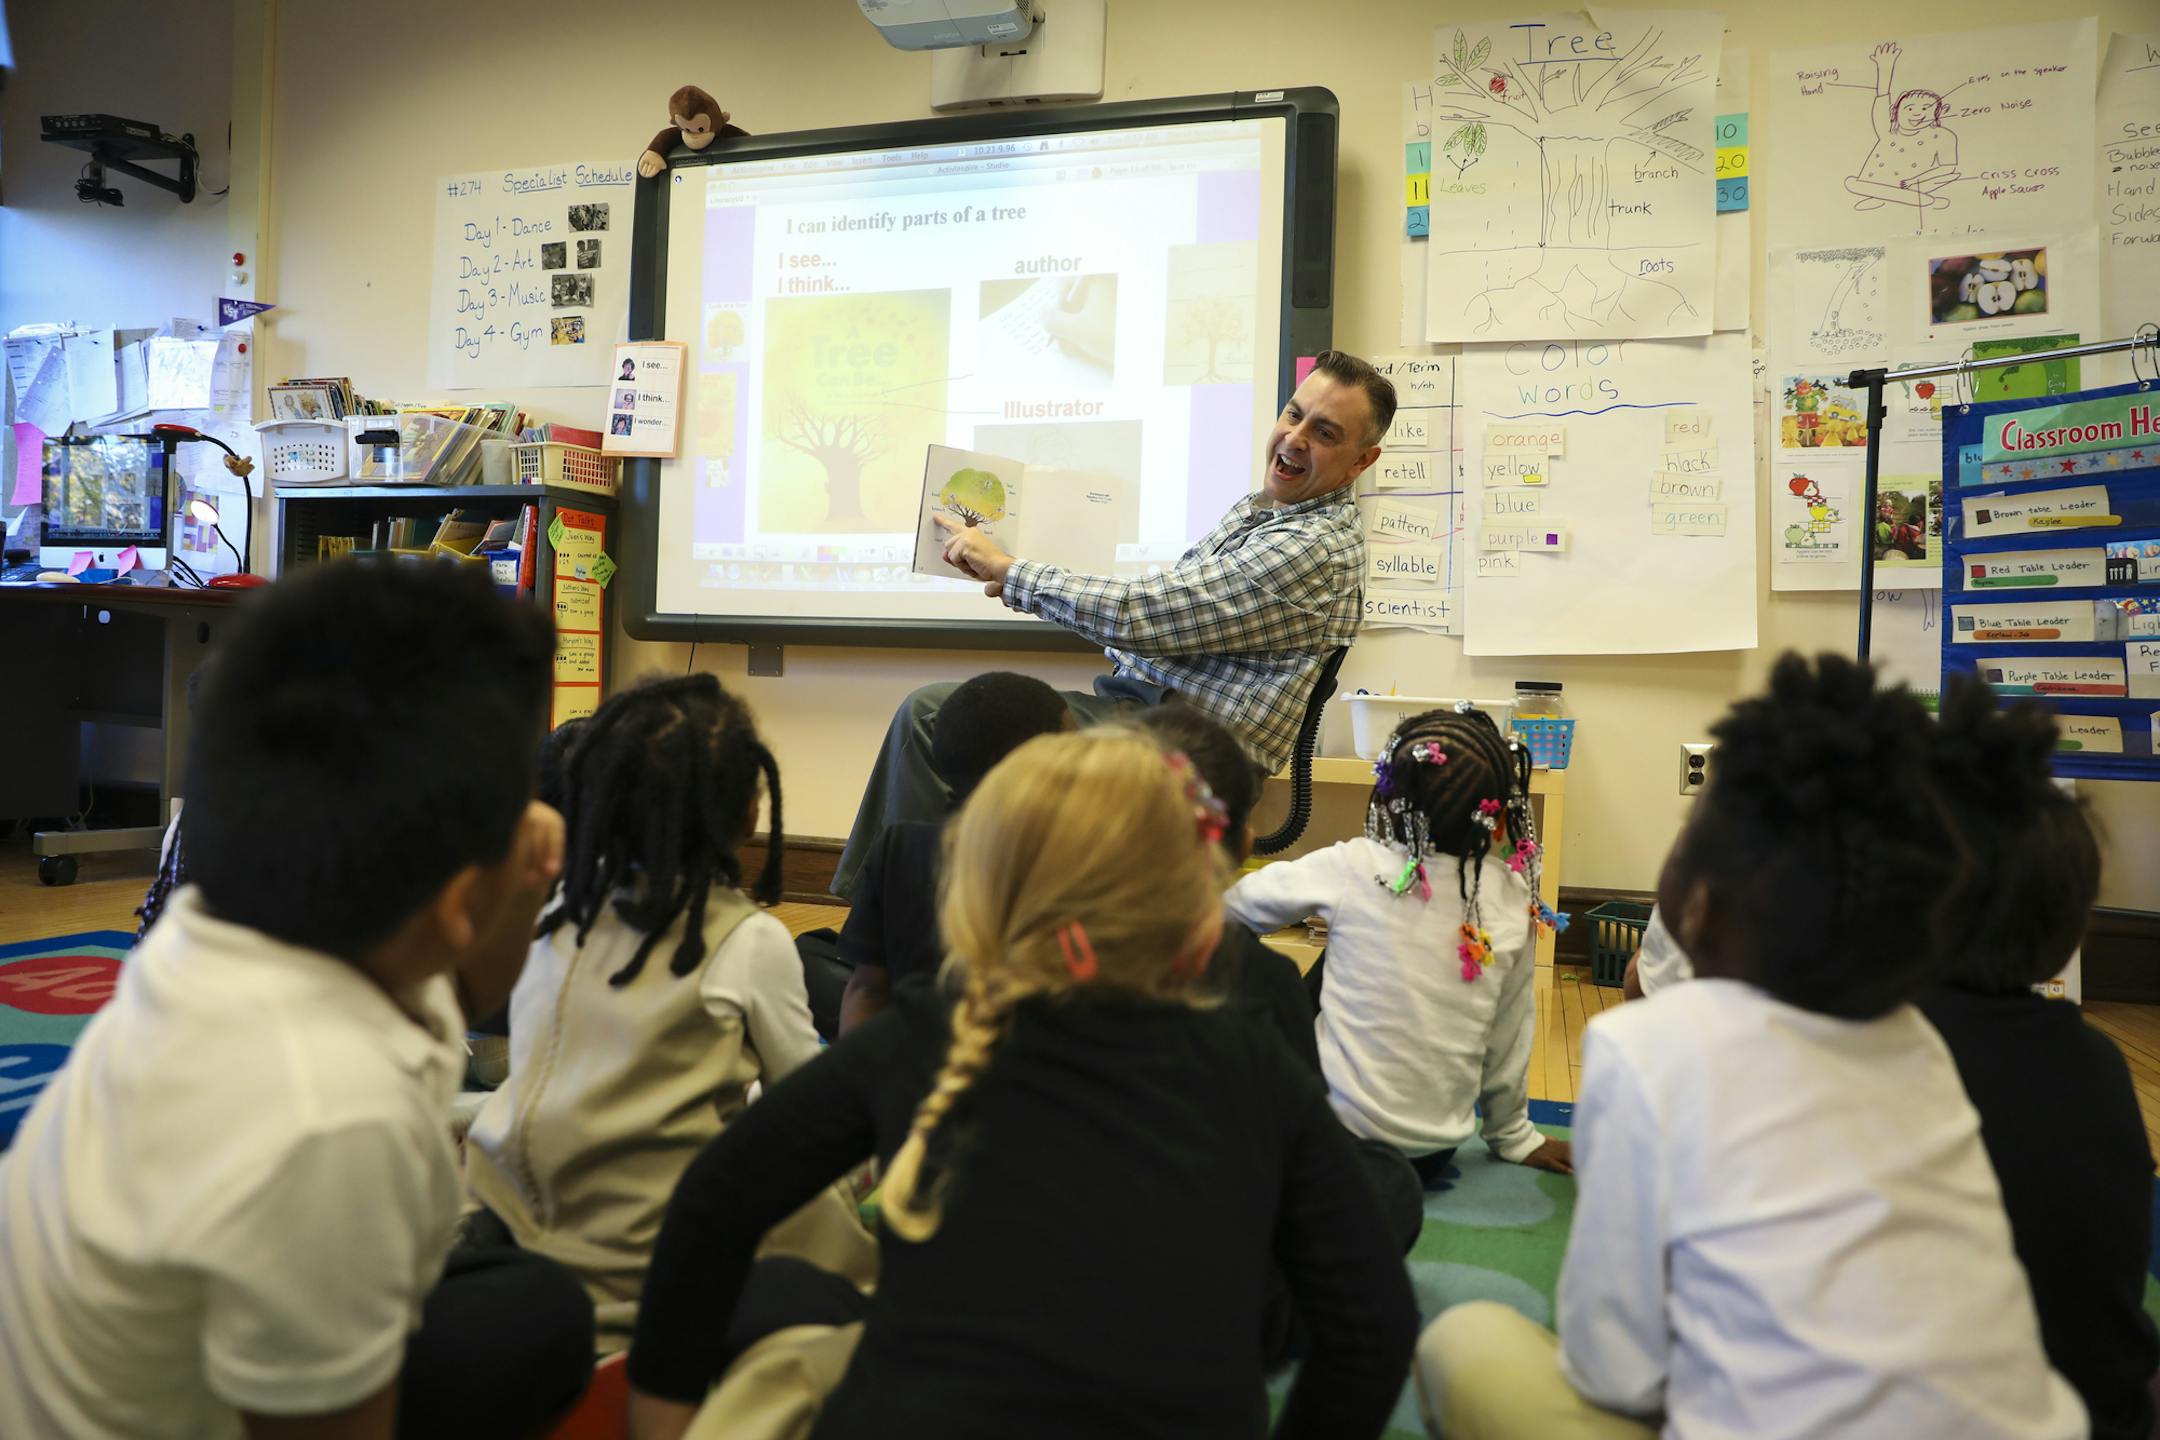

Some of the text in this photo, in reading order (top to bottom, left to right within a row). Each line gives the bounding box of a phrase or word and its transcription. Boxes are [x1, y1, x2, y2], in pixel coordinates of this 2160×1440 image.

[1509, 24, 1617, 64] Tree
[1798, 67, 1839, 81] Raising
[2033, 64, 2068, 75] speaker
[2000, 99, 2033, 111] Noise
[1716, 121, 1737, 142] 10
[882, 153, 903, 163] Tools
[911, 150, 929, 162] Help
[1715, 153, 1745, 171] 20
[448, 164, 633, 197] #274 Specialist Schedule
[1633, 165, 1679, 182] branch
[1716, 186, 1746, 203] 30
[1608, 199, 1653, 215] trunk
[786, 204, 1027, 235] I can identify parts of a tree
[464, 222, 492, 248] Day
[512, 217, 552, 237] Dance
[460, 256, 490, 285] Day
[512, 249, 535, 271] Art
[778, 253, 784, 269] I
[1014, 254, 1083, 275] author
[1638, 257, 1675, 275] roots
[778, 277, 783, 294] I
[457, 289, 485, 320] Day
[508, 282, 546, 309] Music
[455, 327, 481, 359] Day
[510, 321, 543, 350] Gym
[1372, 362, 1393, 375] ord
[1394, 422, 1426, 438] like
[1672, 416, 1701, 433] red
[1492, 431, 1562, 451] orange
[2000, 419, 2123, 452] Classroom
[1383, 461, 1426, 480] retell
[1487, 455, 1540, 480] yellow
[1660, 474, 1714, 498] brown
[1495, 494, 1536, 514] blue
[1993, 510, 2022, 519] Brown
[2060, 500, 2097, 511] Leader
[1380, 513, 1431, 538] pattern
[1664, 512, 1720, 531] green
[1488, 527, 1539, 549] purple
[1376, 554, 1437, 575] syllable
[1478, 550, 1515, 572] pink
[1991, 561, 2090, 575] Red Table Leader
[1365, 600, 1450, 620] scientist
[1978, 616, 2071, 629] Blue Table Leader
[2008, 670, 2116, 684] Purple Table Leader
[2069, 726, 2110, 736] Leader
